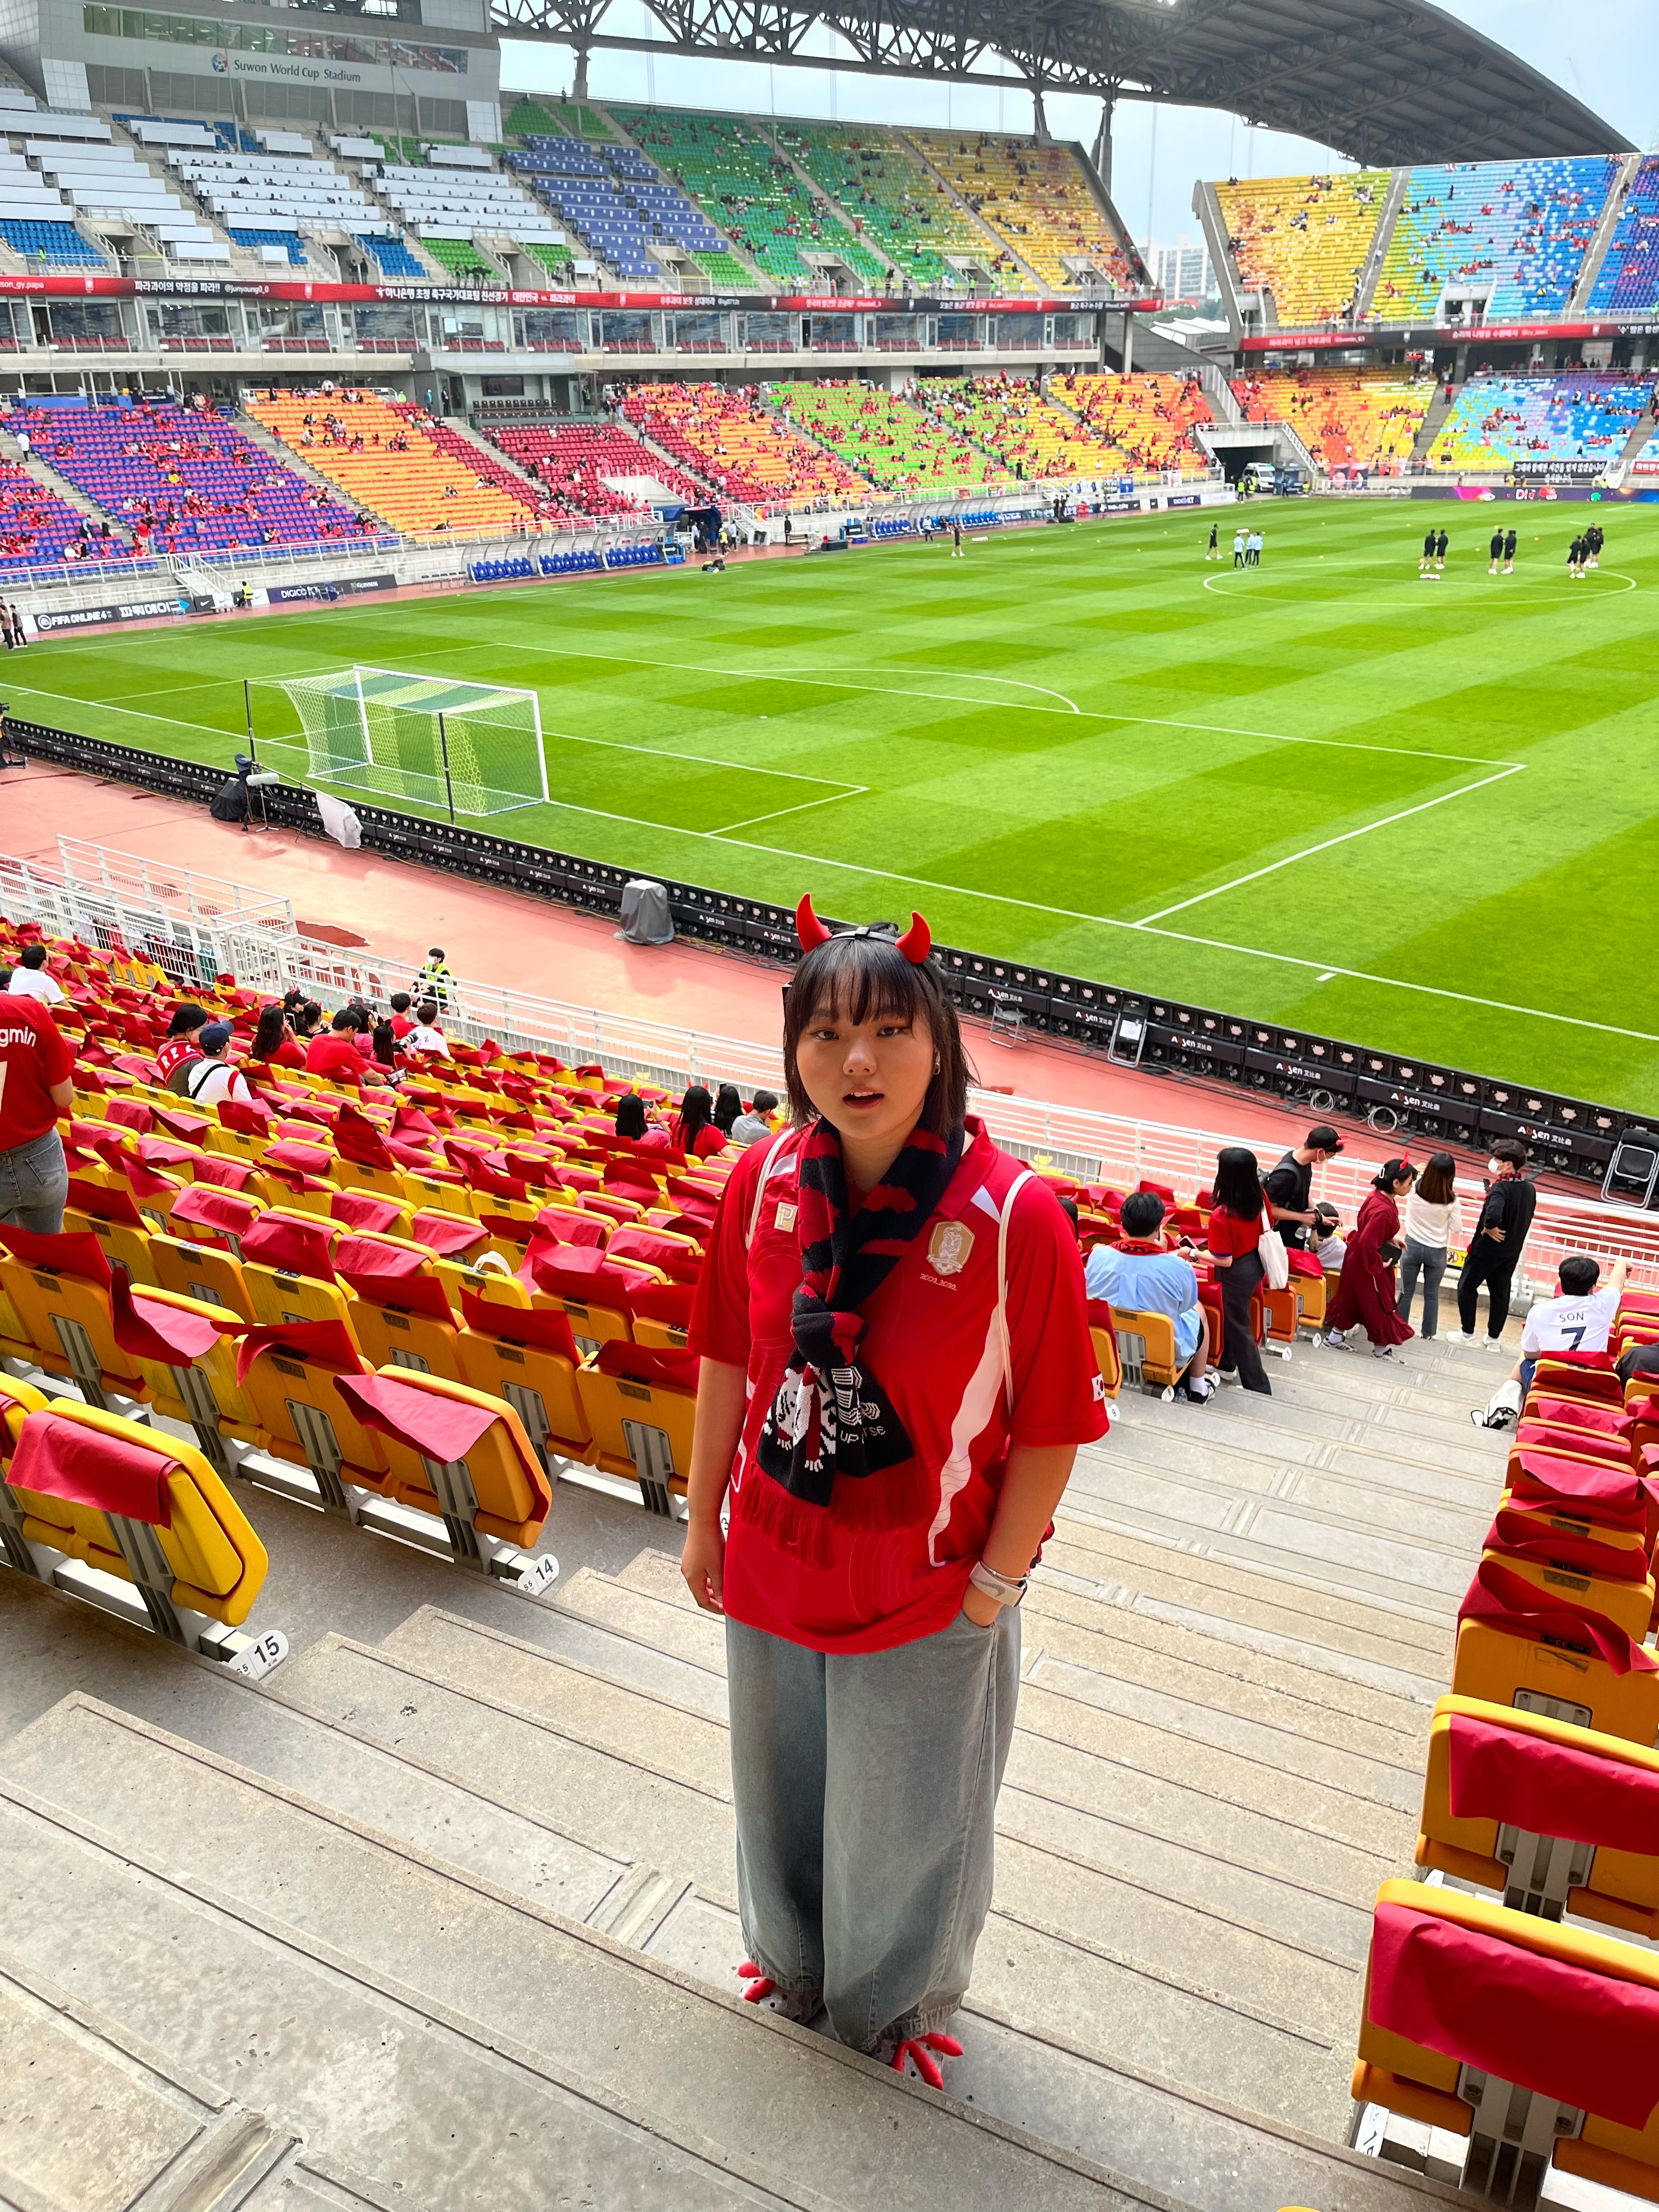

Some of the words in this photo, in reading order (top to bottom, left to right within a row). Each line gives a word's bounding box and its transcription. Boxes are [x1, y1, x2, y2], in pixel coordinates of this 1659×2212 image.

[234, 59, 267, 73] Suwon
[270, 63, 300, 76] World
[301, 67, 320, 81] Cup
[323, 69, 361, 82] Stadium
[134, 280, 174, 292] 파라과이의
[175, 282, 199, 293] 약점을
[200, 283, 221, 293] 파라!!
[385, 287, 414, 300] 하나은행
[415, 289, 431, 300] 초청
[431, 289, 480, 301] 축구국가대표팀
[481, 290, 509, 302] 친선경기
[52, 616, 71, 626] FIFA
[70, 611, 101, 623] ONLINE
[100, 611, 108, 620] 4
[1276, 1063, 1303, 1075] Absen
[1391, 1092, 1420, 1105] Absen
[1517, 1126, 1550, 1141] Absen
[1559, 1312, 1584, 1323] SON
[1561, 1325, 1587, 1352] 7
[535, 1558, 554, 1580] 14
[254, 1635, 280, 1663] 15
